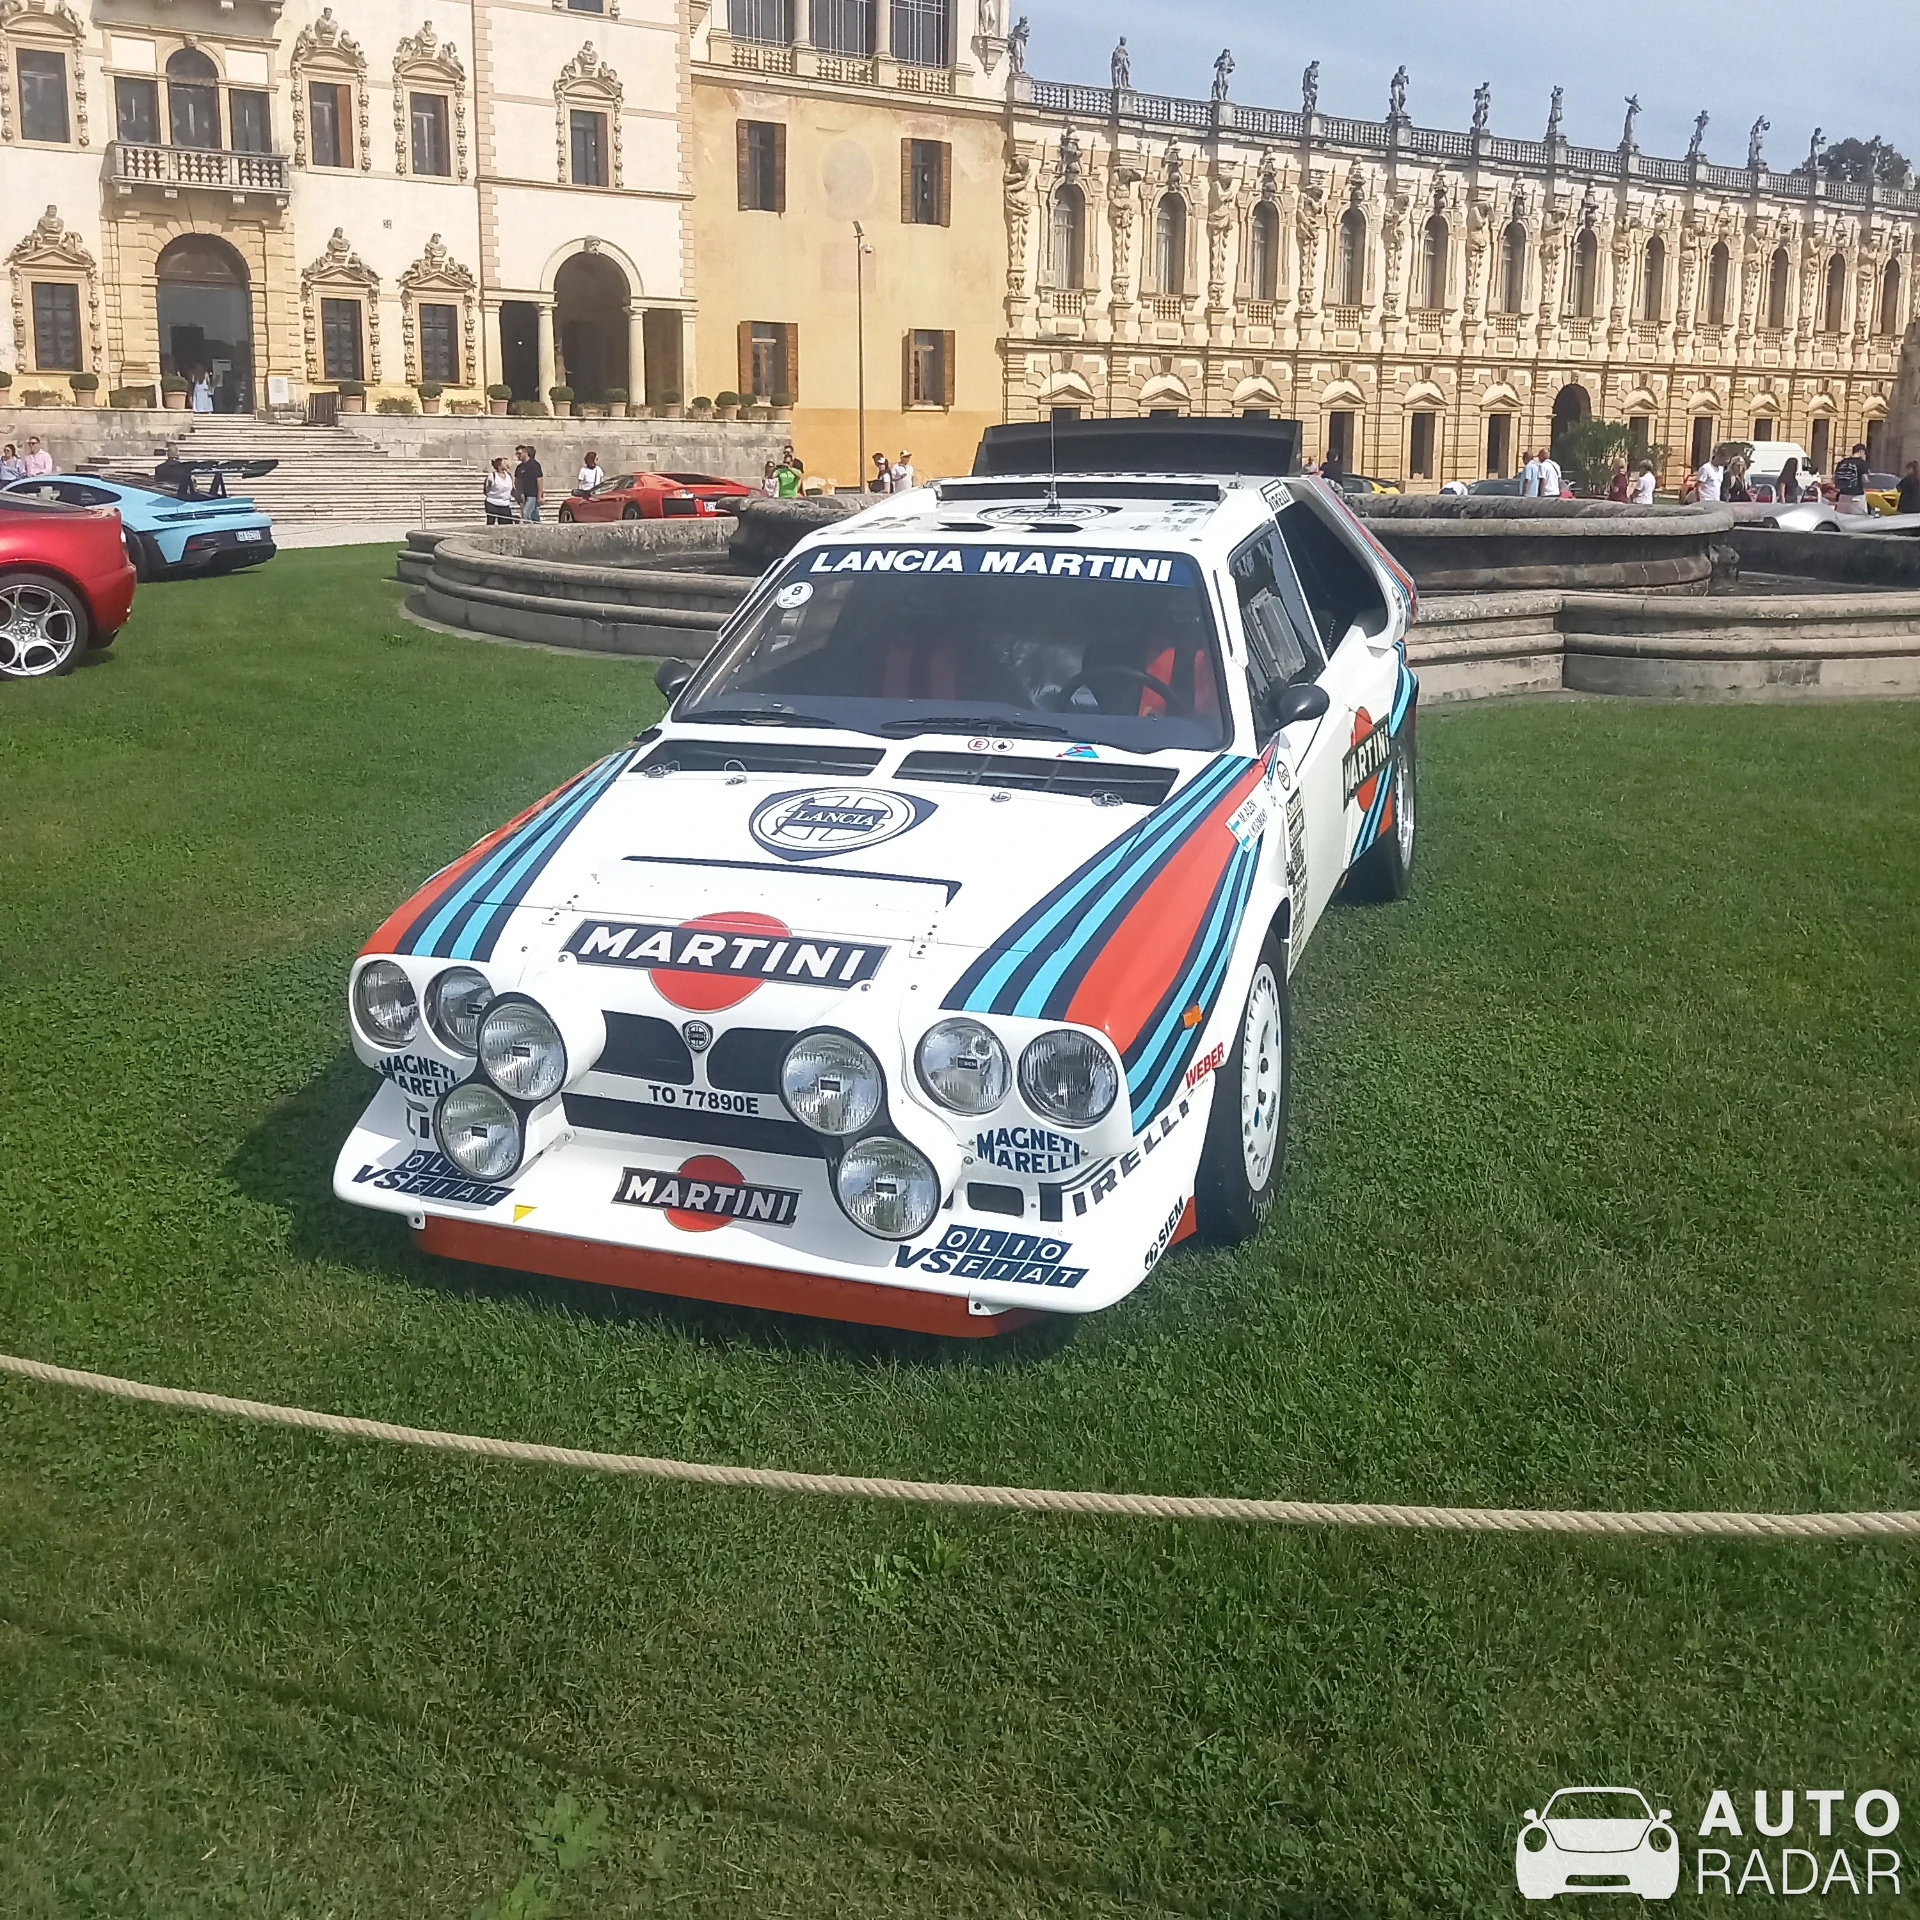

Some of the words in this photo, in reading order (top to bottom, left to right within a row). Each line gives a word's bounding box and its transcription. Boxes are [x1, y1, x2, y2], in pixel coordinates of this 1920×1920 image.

[809, 550, 963, 573] LANCIA
[979, 551, 1172, 582] MARTINI
[791, 585, 803, 595] 8
[973, 741, 984, 753] E
[1344, 723, 1390, 800] MARTINI
[792, 811, 876, 826] LANCIA
[578, 926, 866, 980] MARTINI
[1185, 1042, 1224, 1089] WEBER
[648, 1085, 676, 1103] TO
[682, 1089, 759, 1115] 77890E
[976, 1126, 1080, 1156] MAGNETI
[977, 1145, 1080, 1174] MARELLI
[407, 1178, 504, 1202] FIAT
[624, 1175, 790, 1221] MARTINI
[1158, 1195, 1184, 1248] SIEM
[946, 1229, 1062, 1259] OLIO
[959, 1257, 1081, 1283] FIAT
